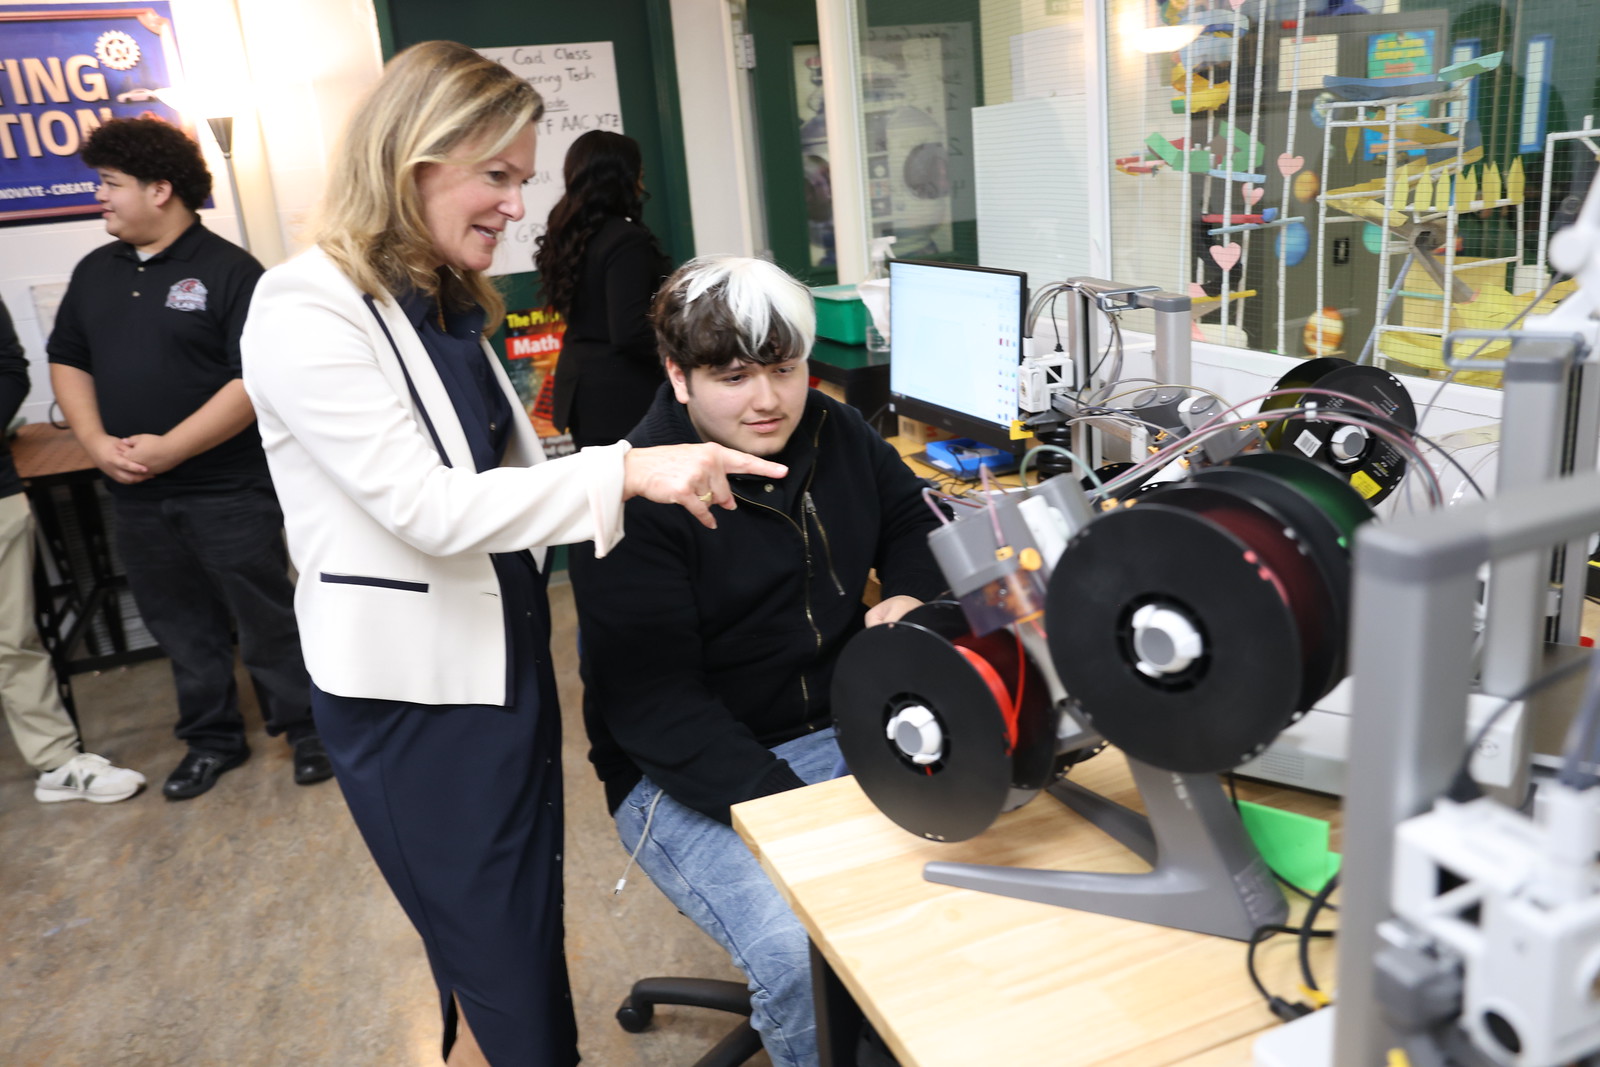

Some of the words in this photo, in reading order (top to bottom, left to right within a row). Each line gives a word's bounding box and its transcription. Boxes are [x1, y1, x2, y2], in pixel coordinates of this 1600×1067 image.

[554, 48, 592, 61] Class
[0, 54, 110, 106] ING
[545, 98, 568, 109] ode
[560, 114, 590, 131] AAC
[506, 313, 529, 328] The
[513, 334, 560, 355] Math
